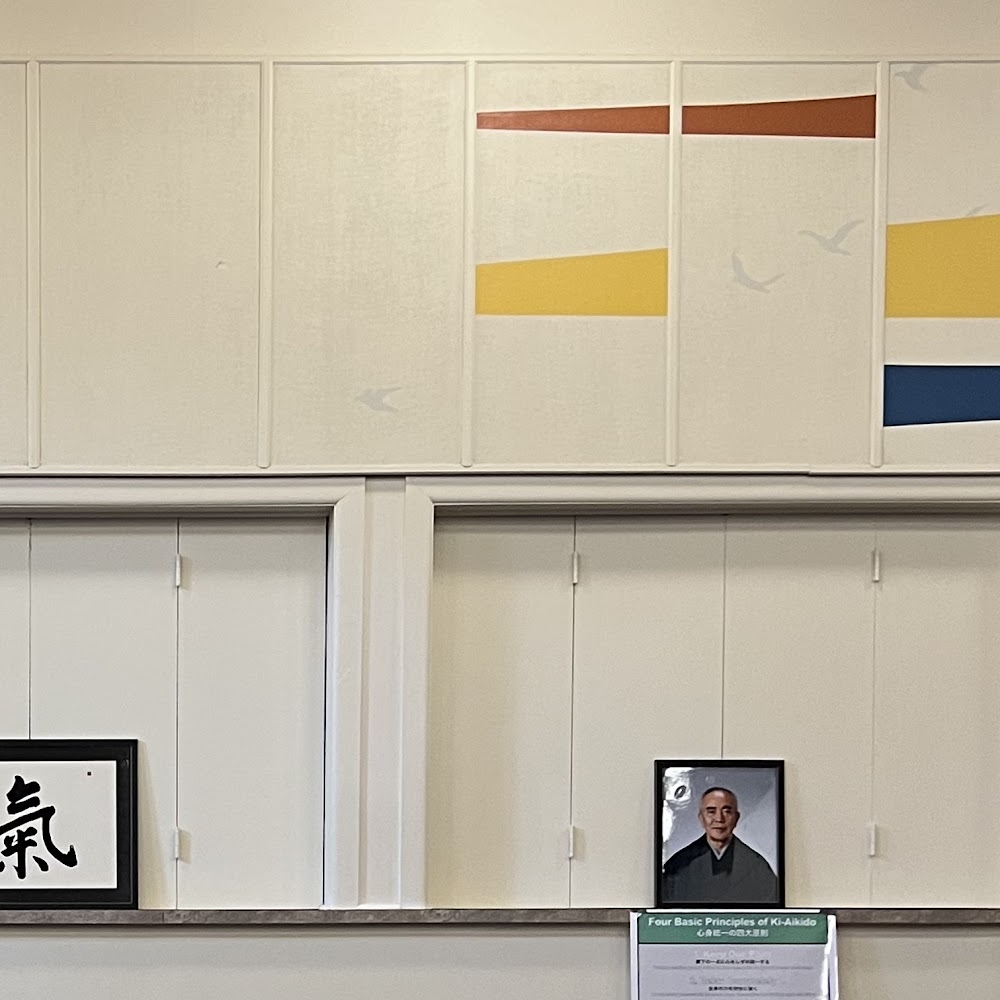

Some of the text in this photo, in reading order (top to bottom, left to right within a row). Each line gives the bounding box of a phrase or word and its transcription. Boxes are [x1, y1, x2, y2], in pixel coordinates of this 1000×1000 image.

[648, 917, 817, 928] Four Basic Principles of Ki-Aikido
